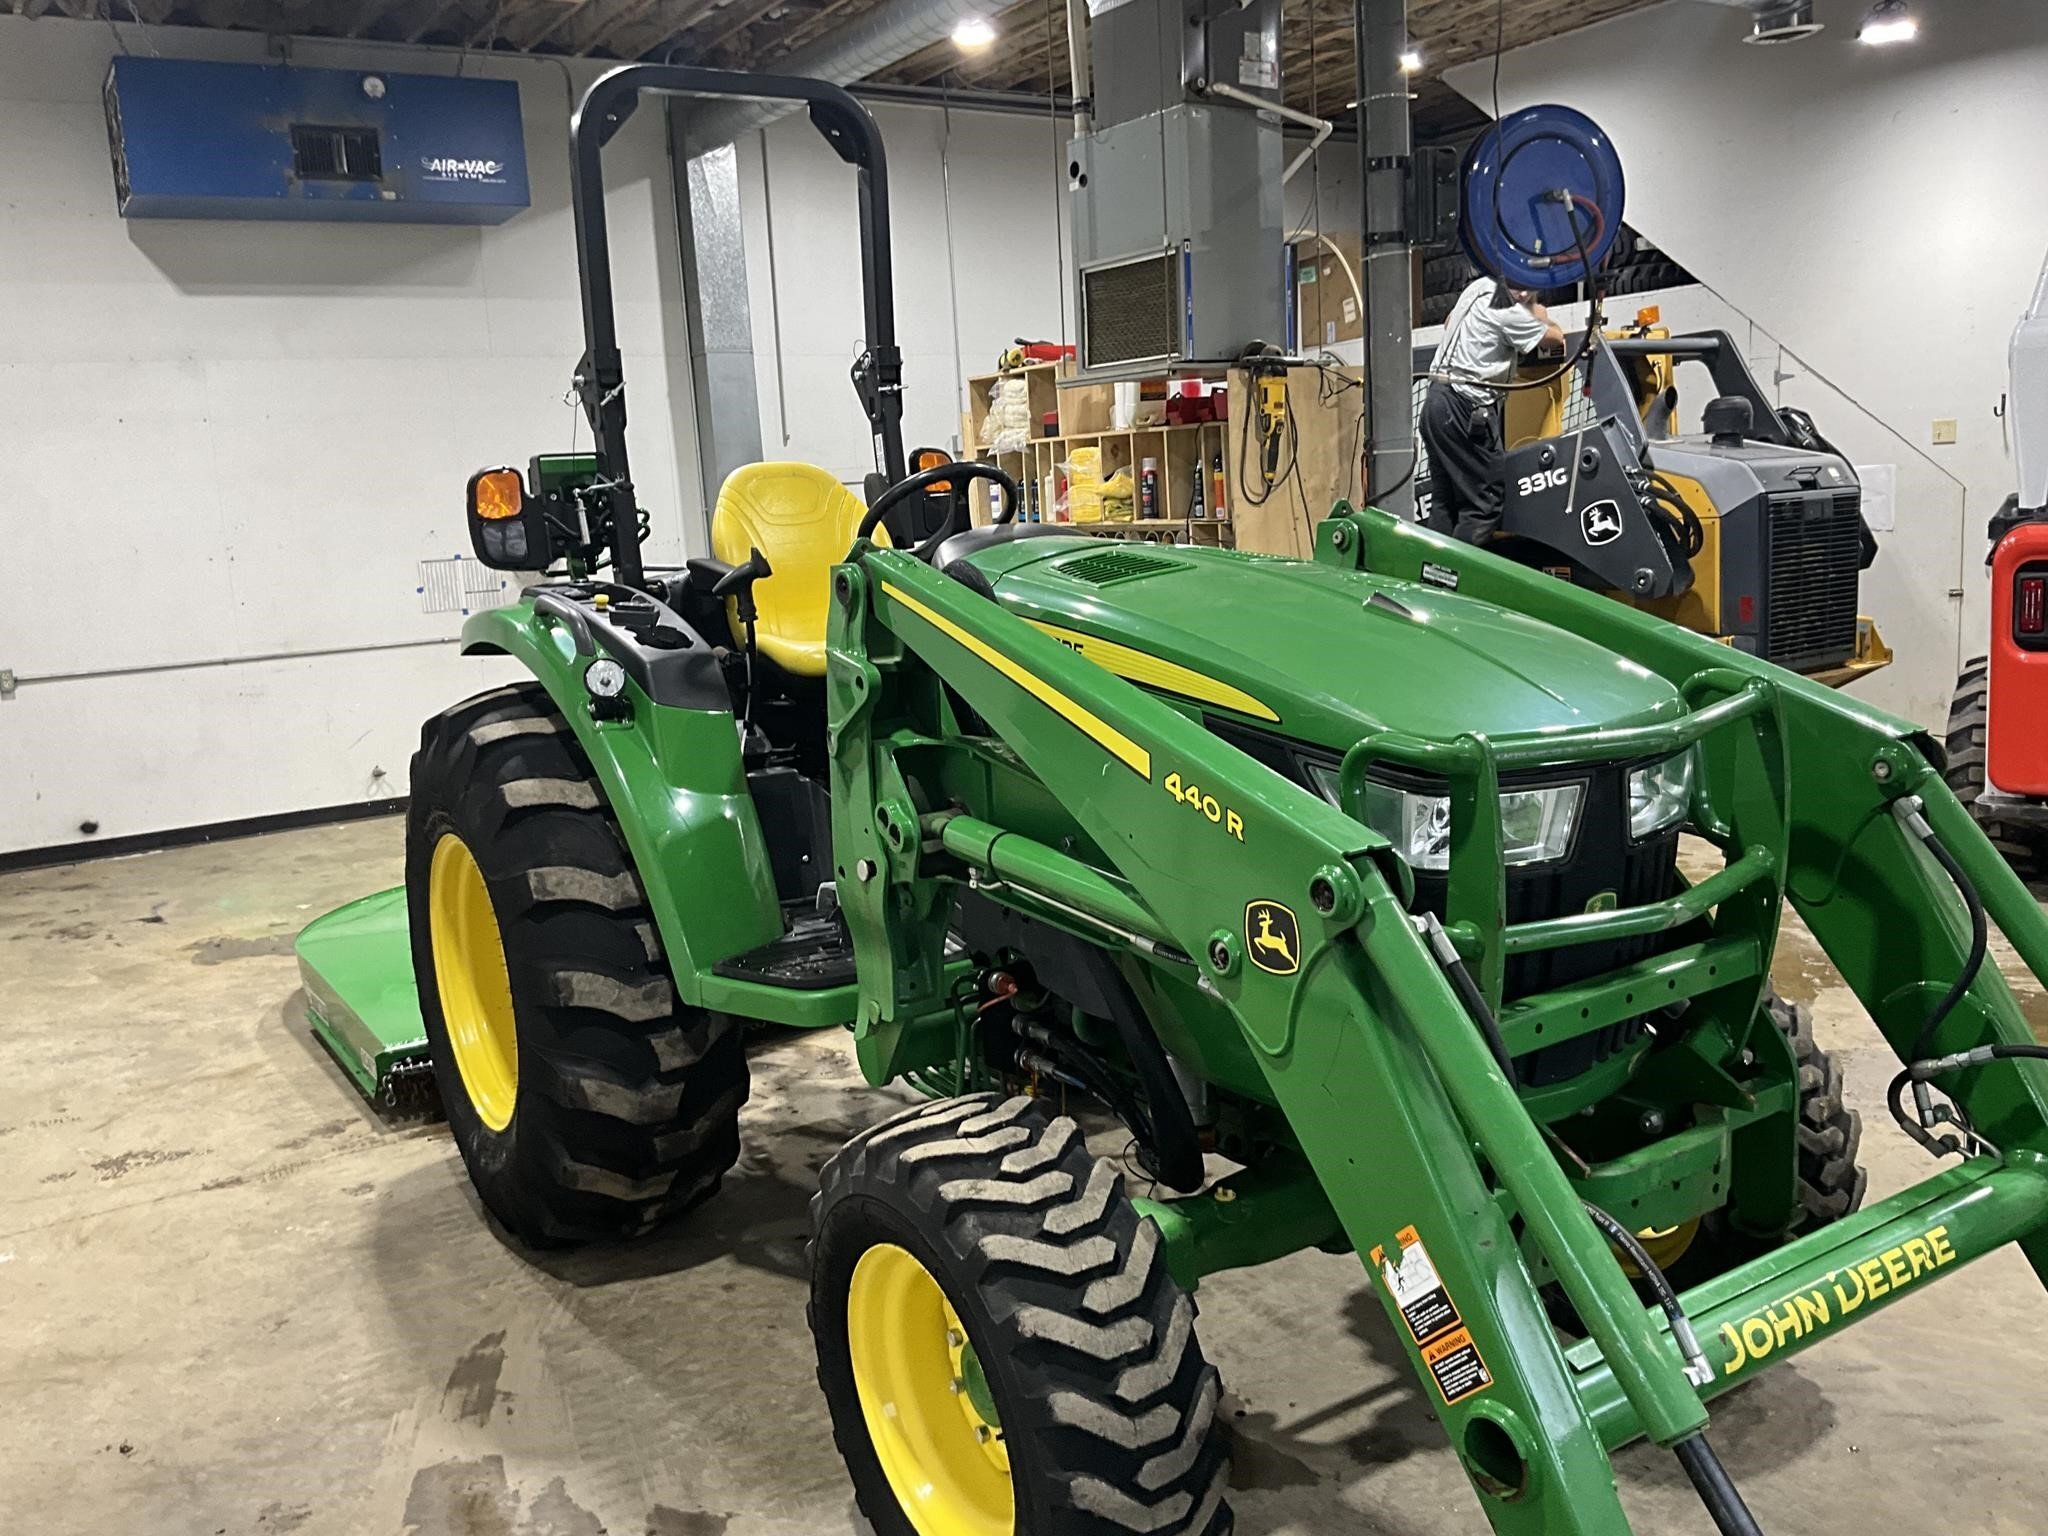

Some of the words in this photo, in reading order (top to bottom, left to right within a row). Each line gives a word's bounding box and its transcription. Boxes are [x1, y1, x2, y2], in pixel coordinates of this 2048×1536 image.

[1517, 467, 1568, 497] 331G
[1164, 771, 1222, 824] 440
[1226, 807, 1245, 844] R
[1719, 1290, 1831, 1375] JOHN
[1826, 1225, 1956, 1315] DEERE
[1435, 1334, 1466, 1356] WARNING
